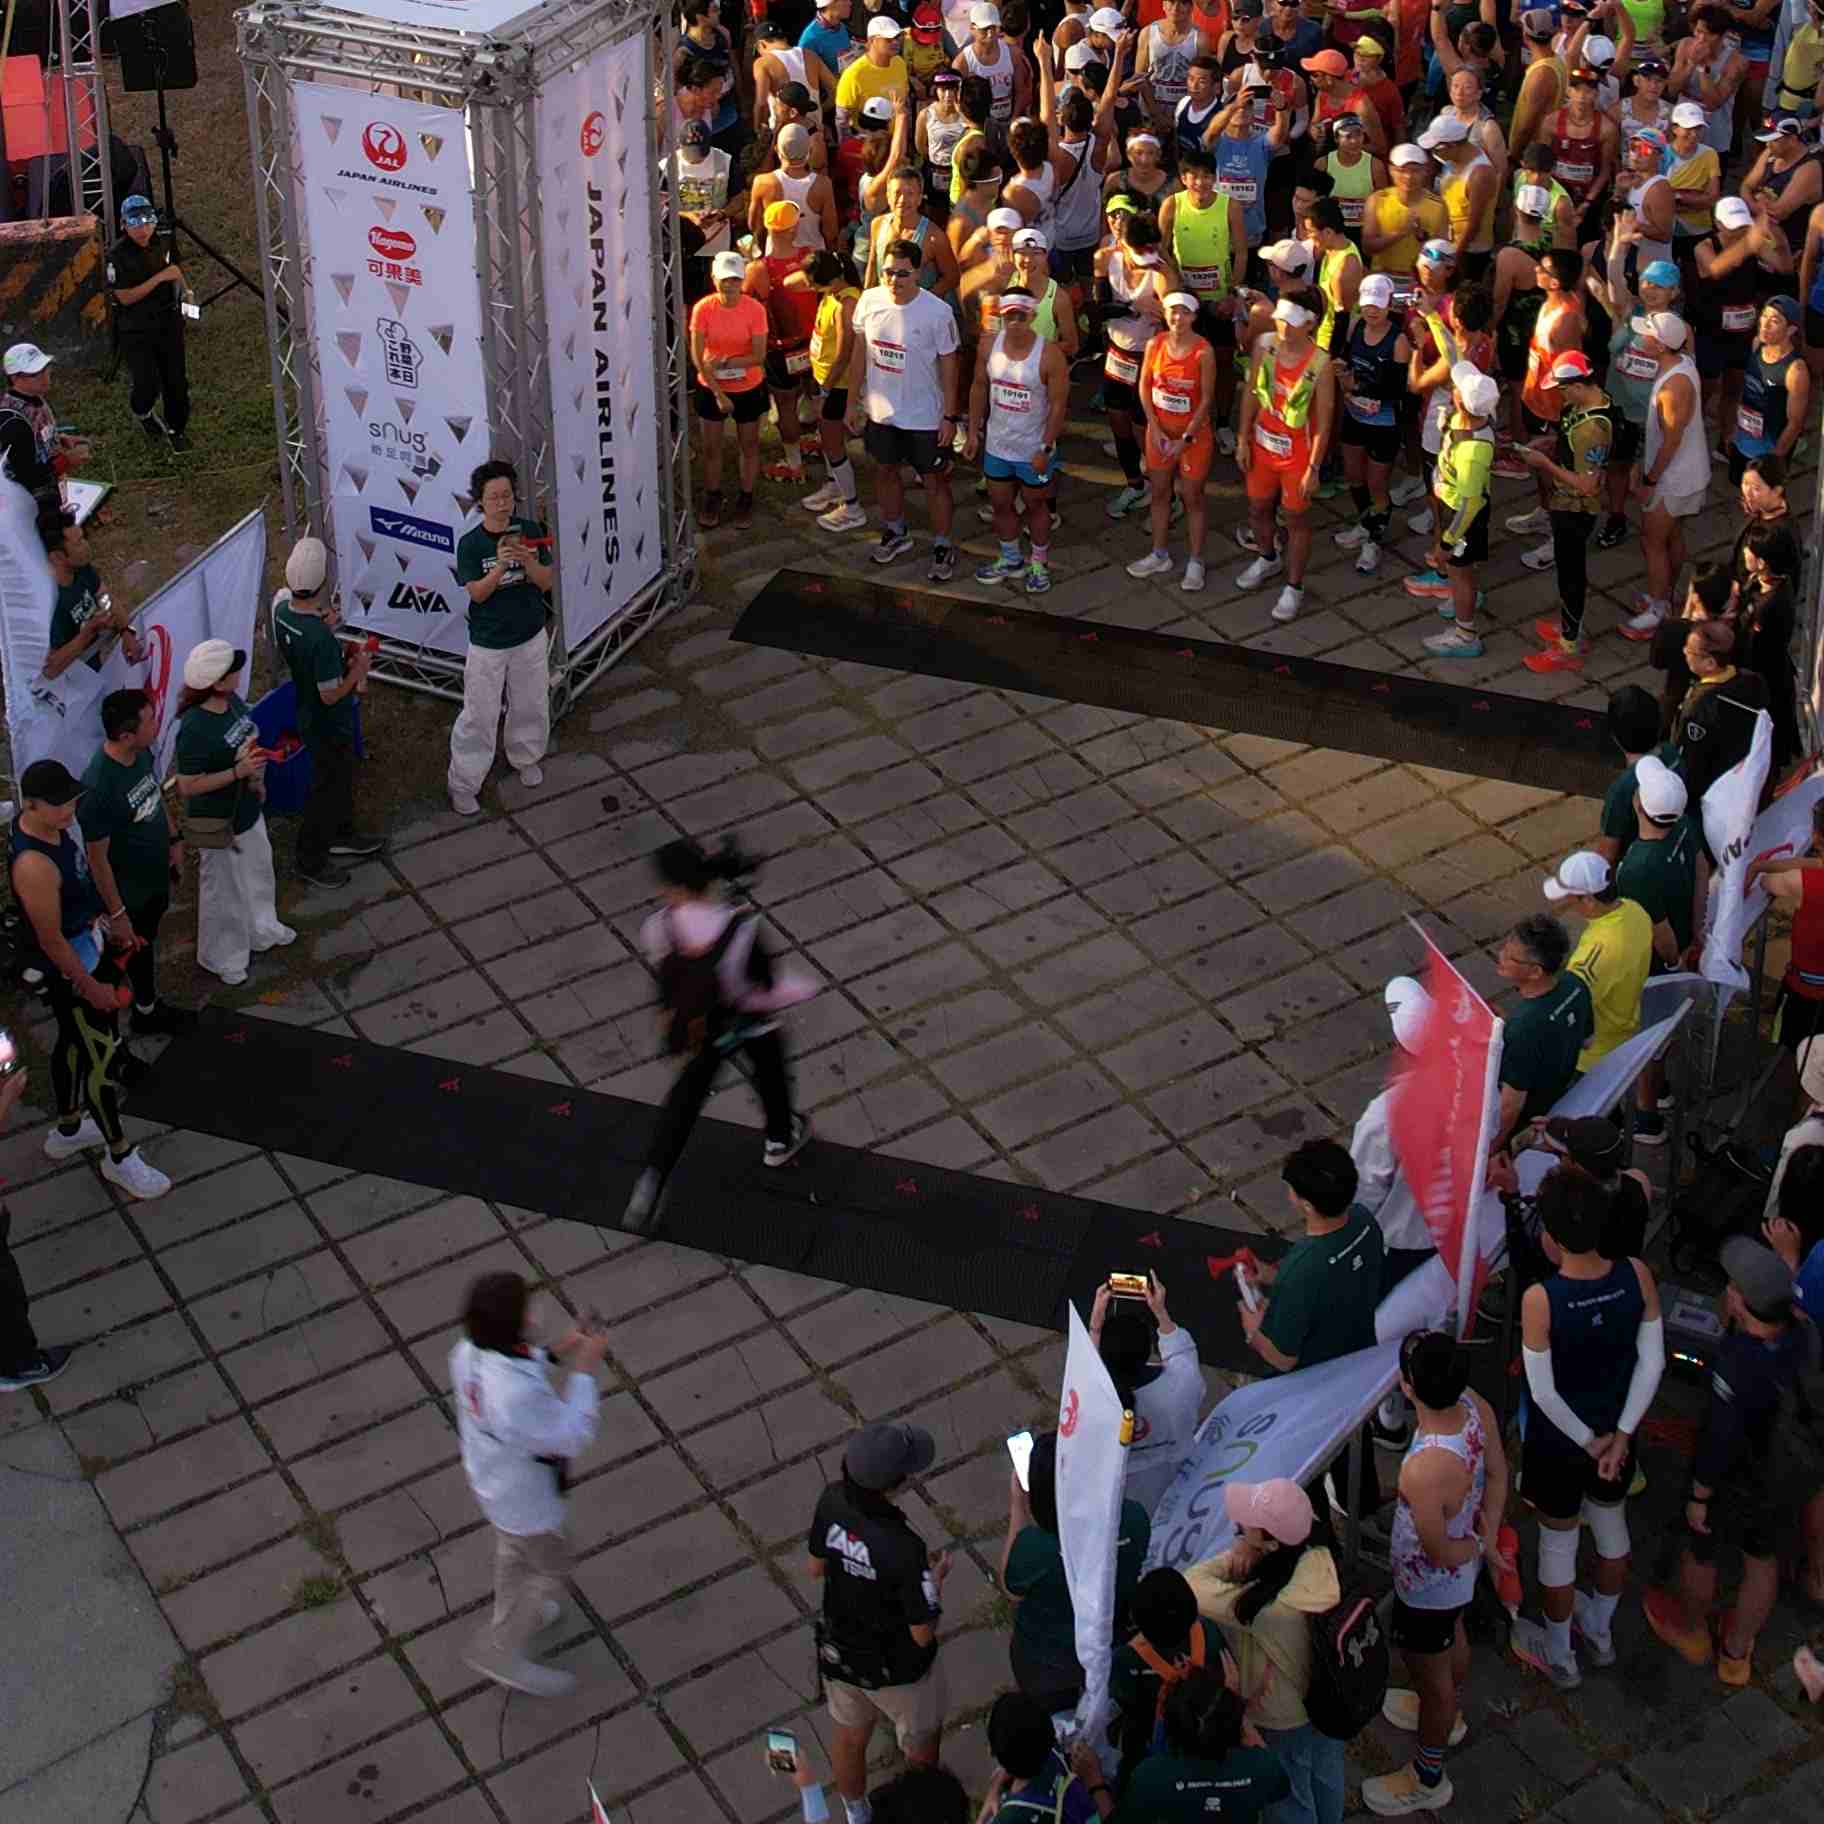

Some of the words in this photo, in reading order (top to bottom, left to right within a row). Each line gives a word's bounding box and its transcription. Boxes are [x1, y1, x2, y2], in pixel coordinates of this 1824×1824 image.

[376, 155, 401, 168] JAL
[336, 169, 376, 183] JAPAN
[379, 177, 438, 195] AIRLINES
[370, 231, 415, 252] Kagome
[586, 182, 609, 332] JAPAN
[365, 258, 423, 286] 可果美
[368, 422, 426, 453] snug
[594, 349, 619, 566] AIRLINES
[387, 581, 451, 614] LAVA
[825, 1522, 872, 1568] LAVA
[840, 1557, 878, 1582] TEAM
